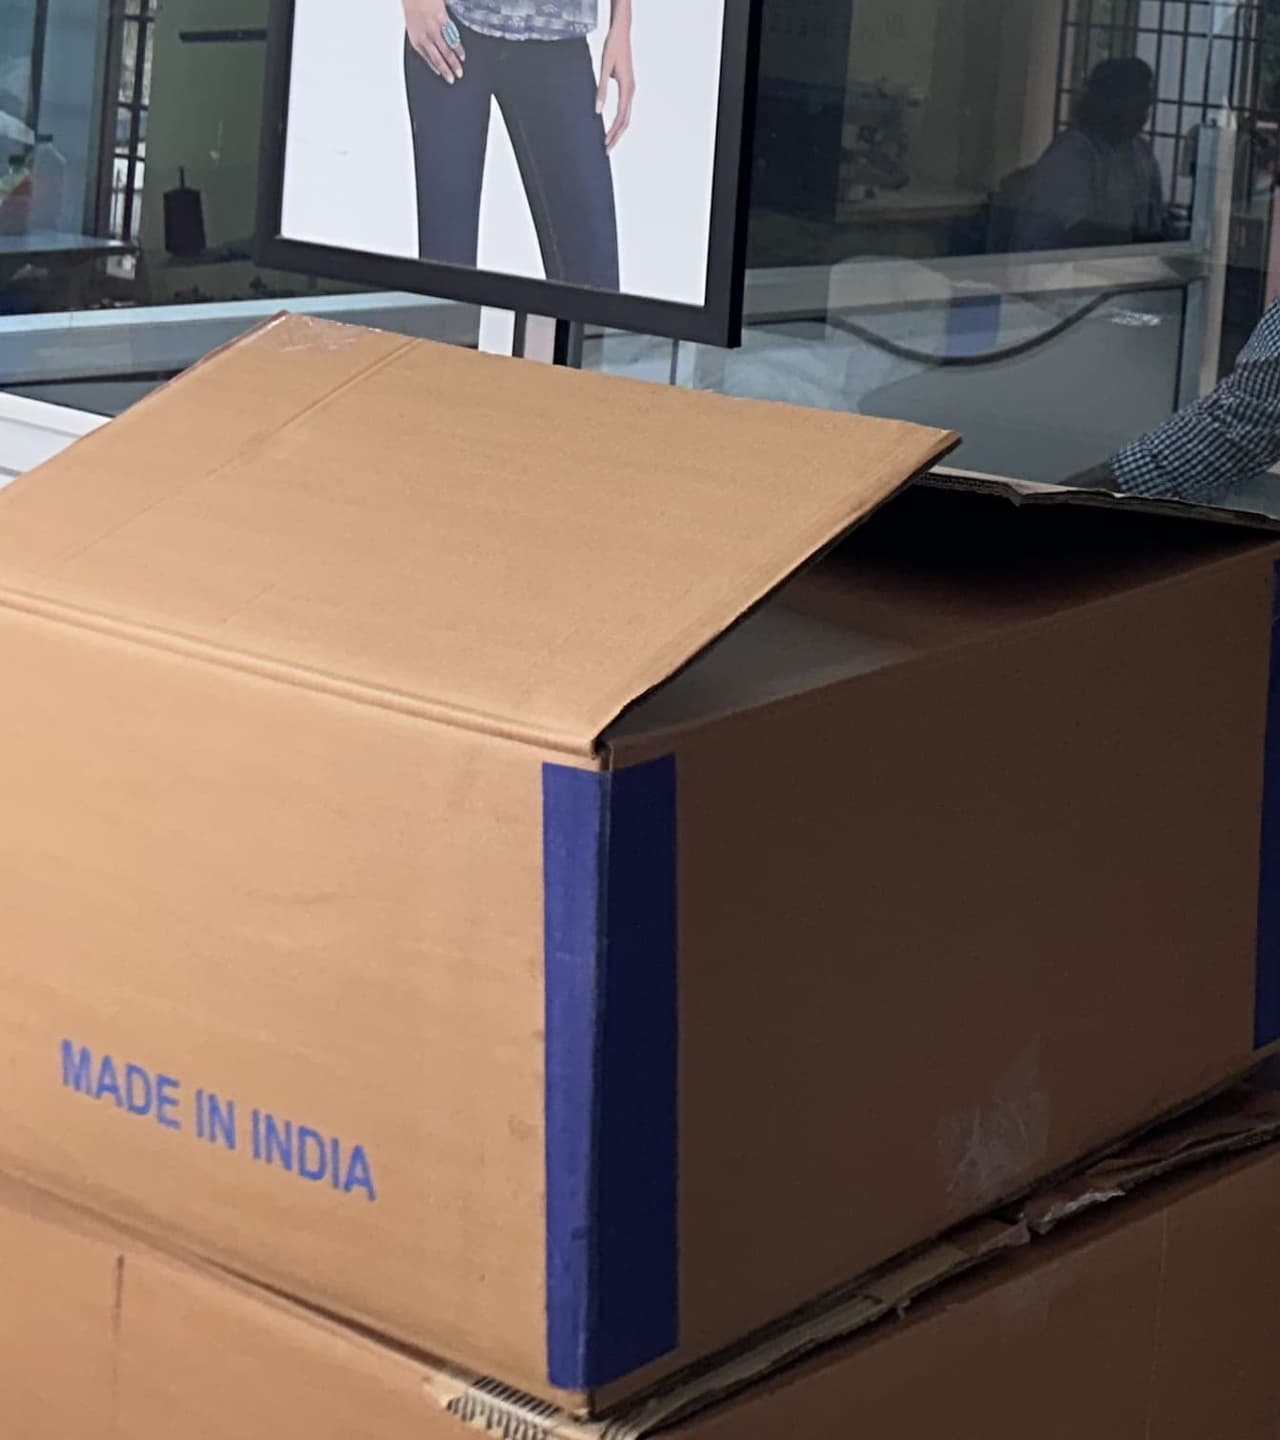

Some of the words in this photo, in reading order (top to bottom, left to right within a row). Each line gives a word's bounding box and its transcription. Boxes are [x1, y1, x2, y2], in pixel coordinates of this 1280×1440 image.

[60, 1039, 180, 1130] MADE
[195, 1090, 236, 1150] IN
[252, 1109, 376, 1201] INDIA
